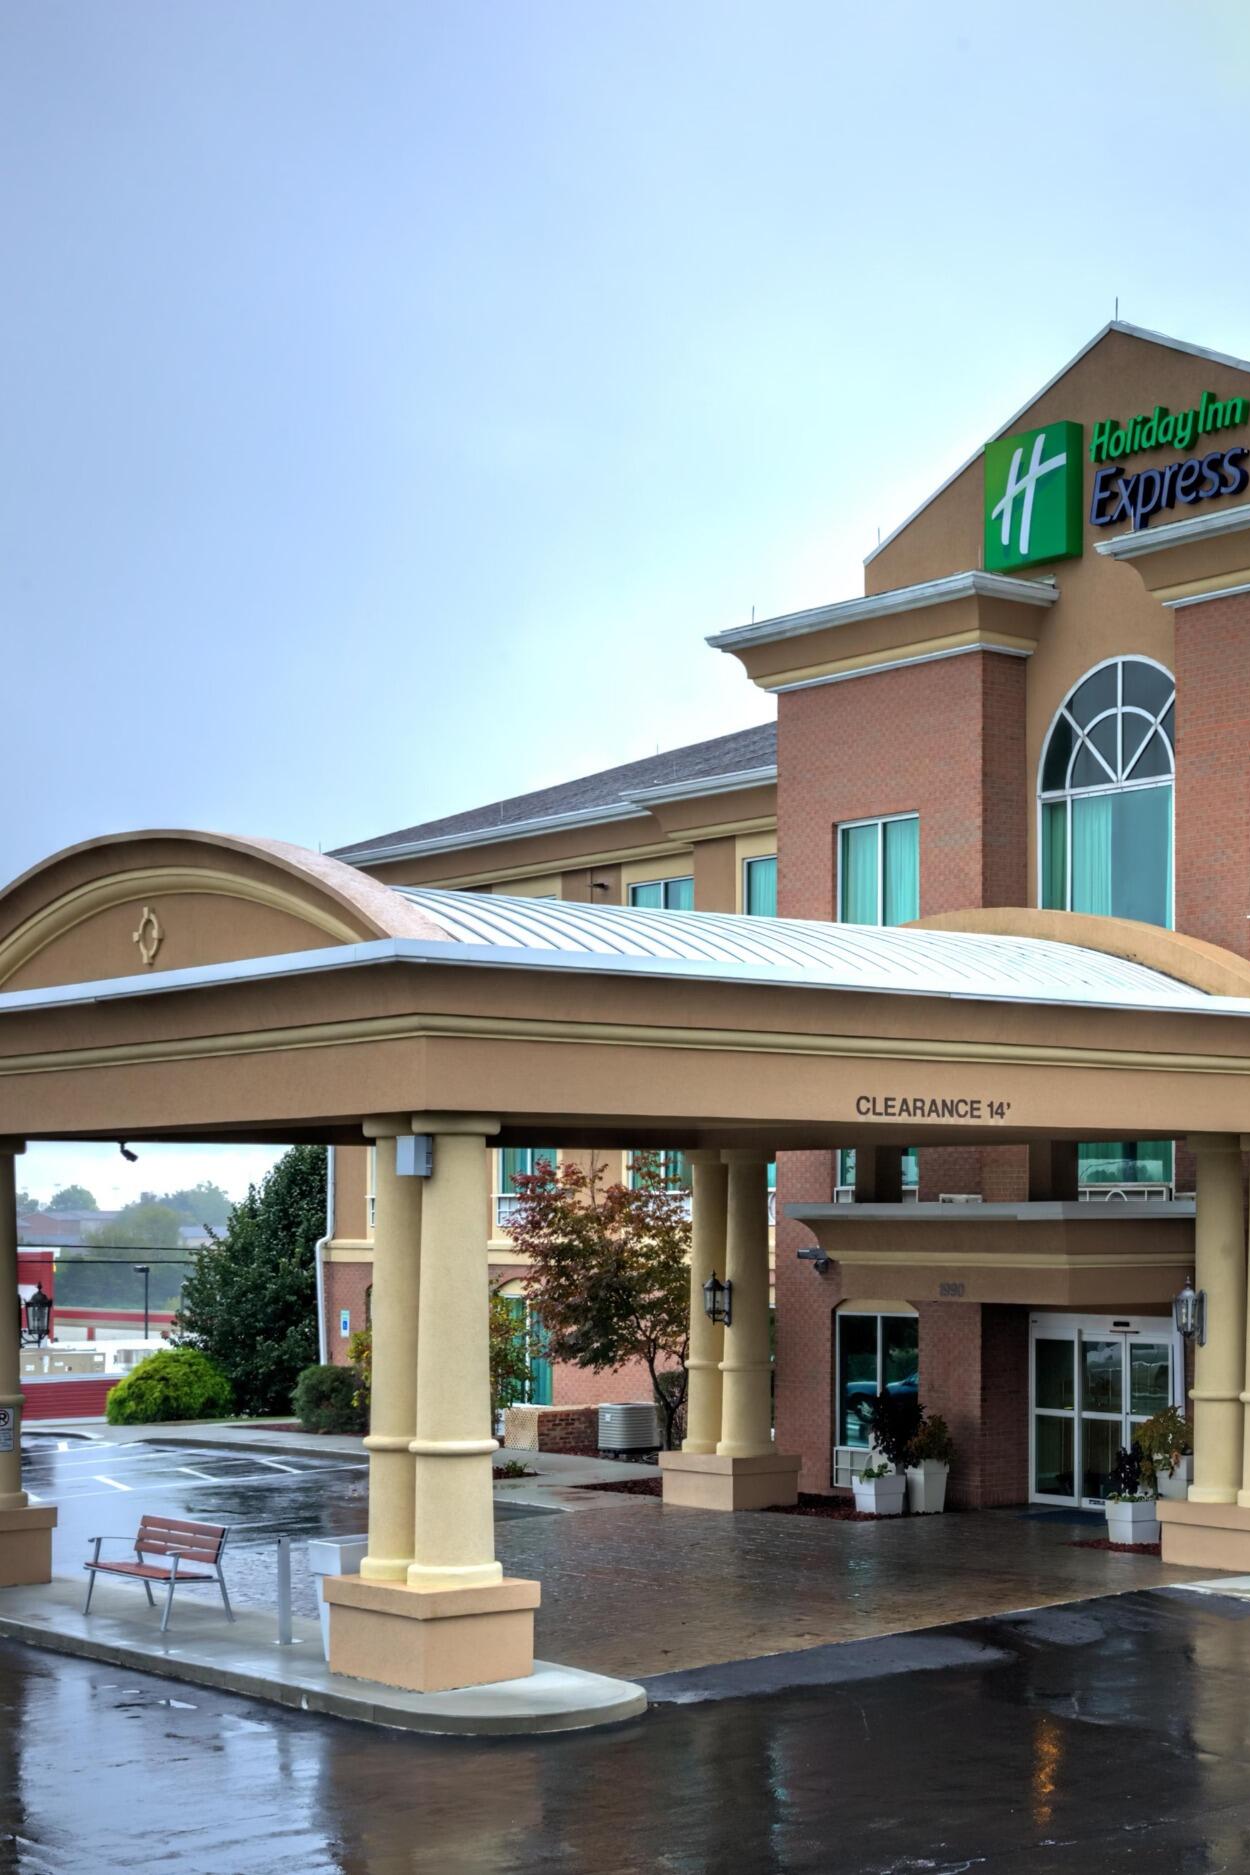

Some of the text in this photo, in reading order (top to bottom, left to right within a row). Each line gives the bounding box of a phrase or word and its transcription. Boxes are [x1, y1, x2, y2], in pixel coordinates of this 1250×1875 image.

[1089, 391, 1250, 463] Holiday Inn
[991, 433, 1067, 555] H
[1089, 447, 1250, 530] Express
[856, 1096, 982, 1119] CLEARANCE
